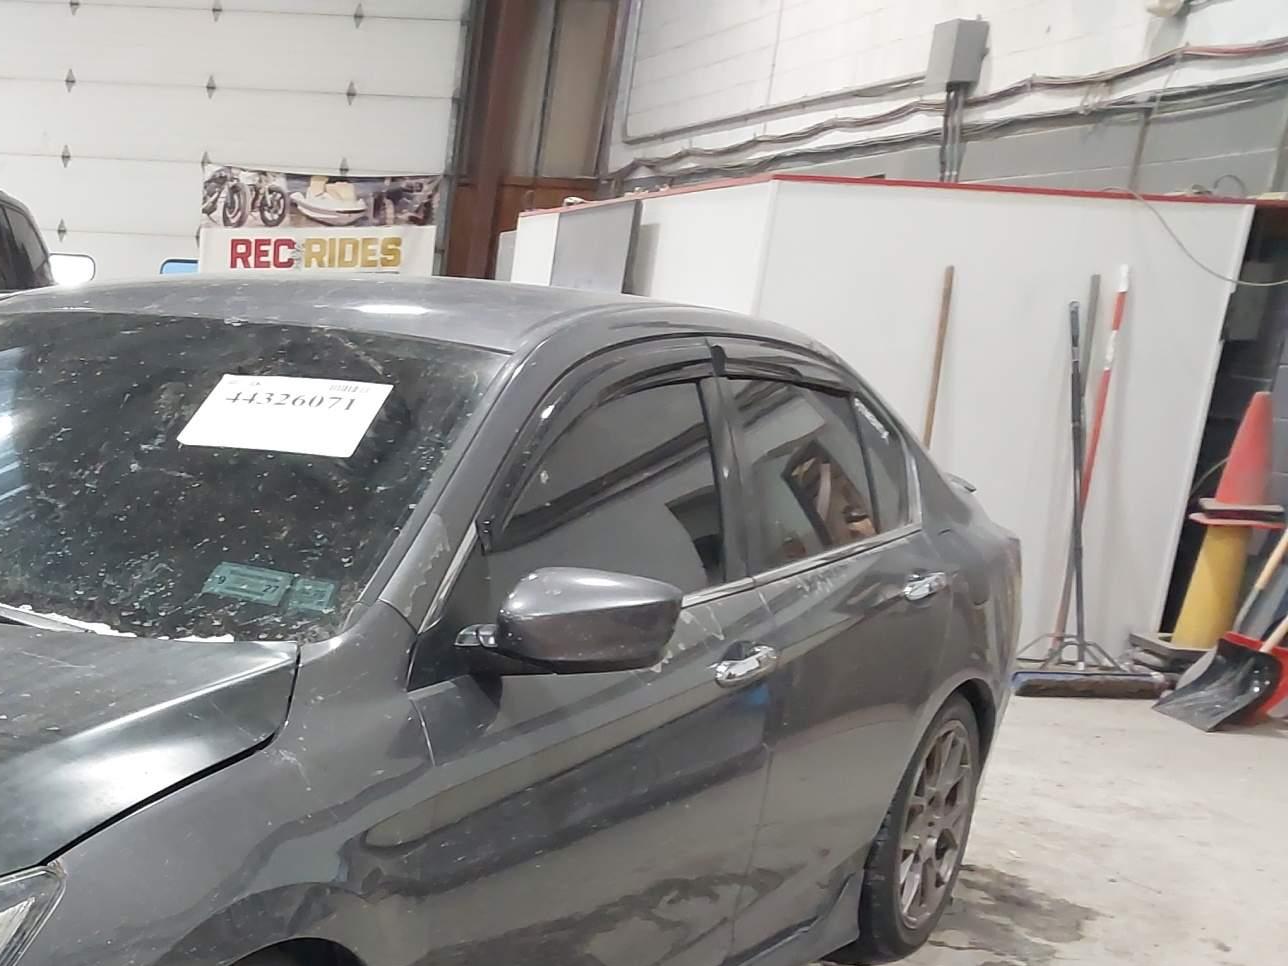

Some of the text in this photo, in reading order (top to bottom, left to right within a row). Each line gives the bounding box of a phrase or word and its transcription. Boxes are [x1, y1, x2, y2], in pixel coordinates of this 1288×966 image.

[230, 237, 402, 269] REC RIDES
[225, 391, 357, 411] 44326071
[262, 584, 279, 593] 27
